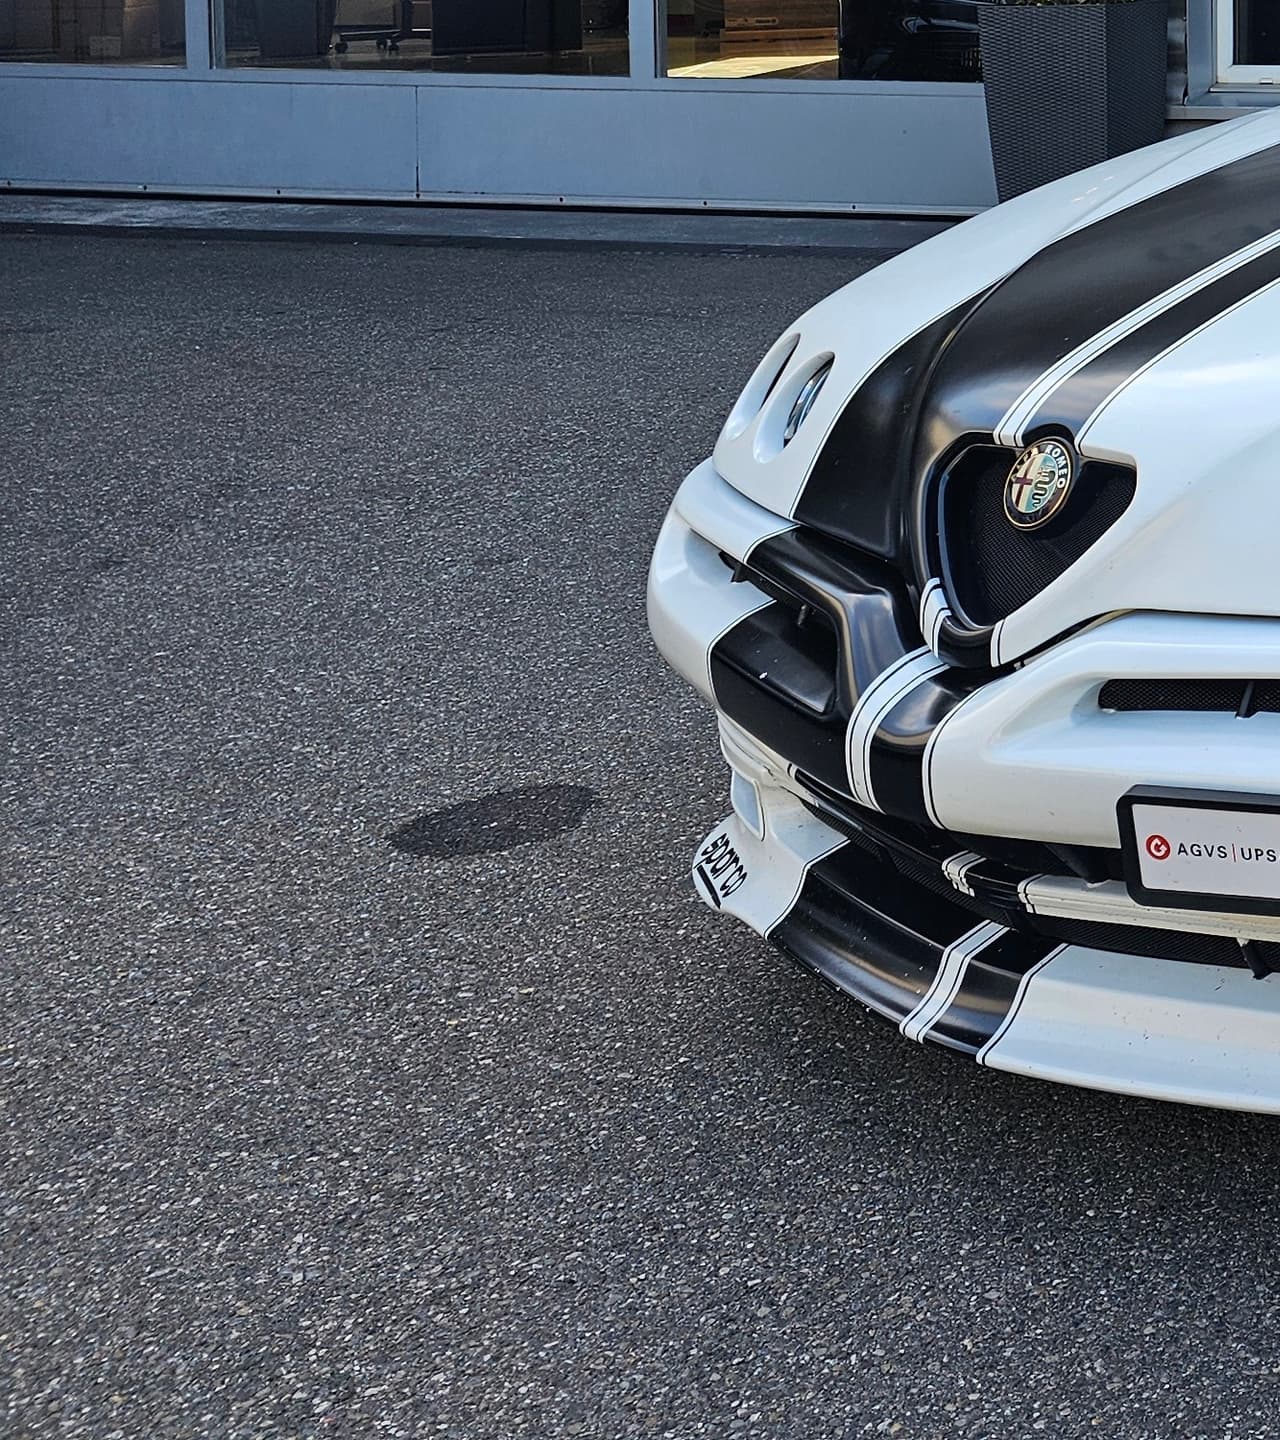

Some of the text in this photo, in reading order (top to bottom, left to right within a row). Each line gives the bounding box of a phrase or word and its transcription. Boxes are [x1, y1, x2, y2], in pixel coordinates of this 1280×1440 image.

[1045, 444, 1068, 489] ROMEO
[693, 833, 748, 898] sparco
[1177, 842, 1228, 859] AGVS
